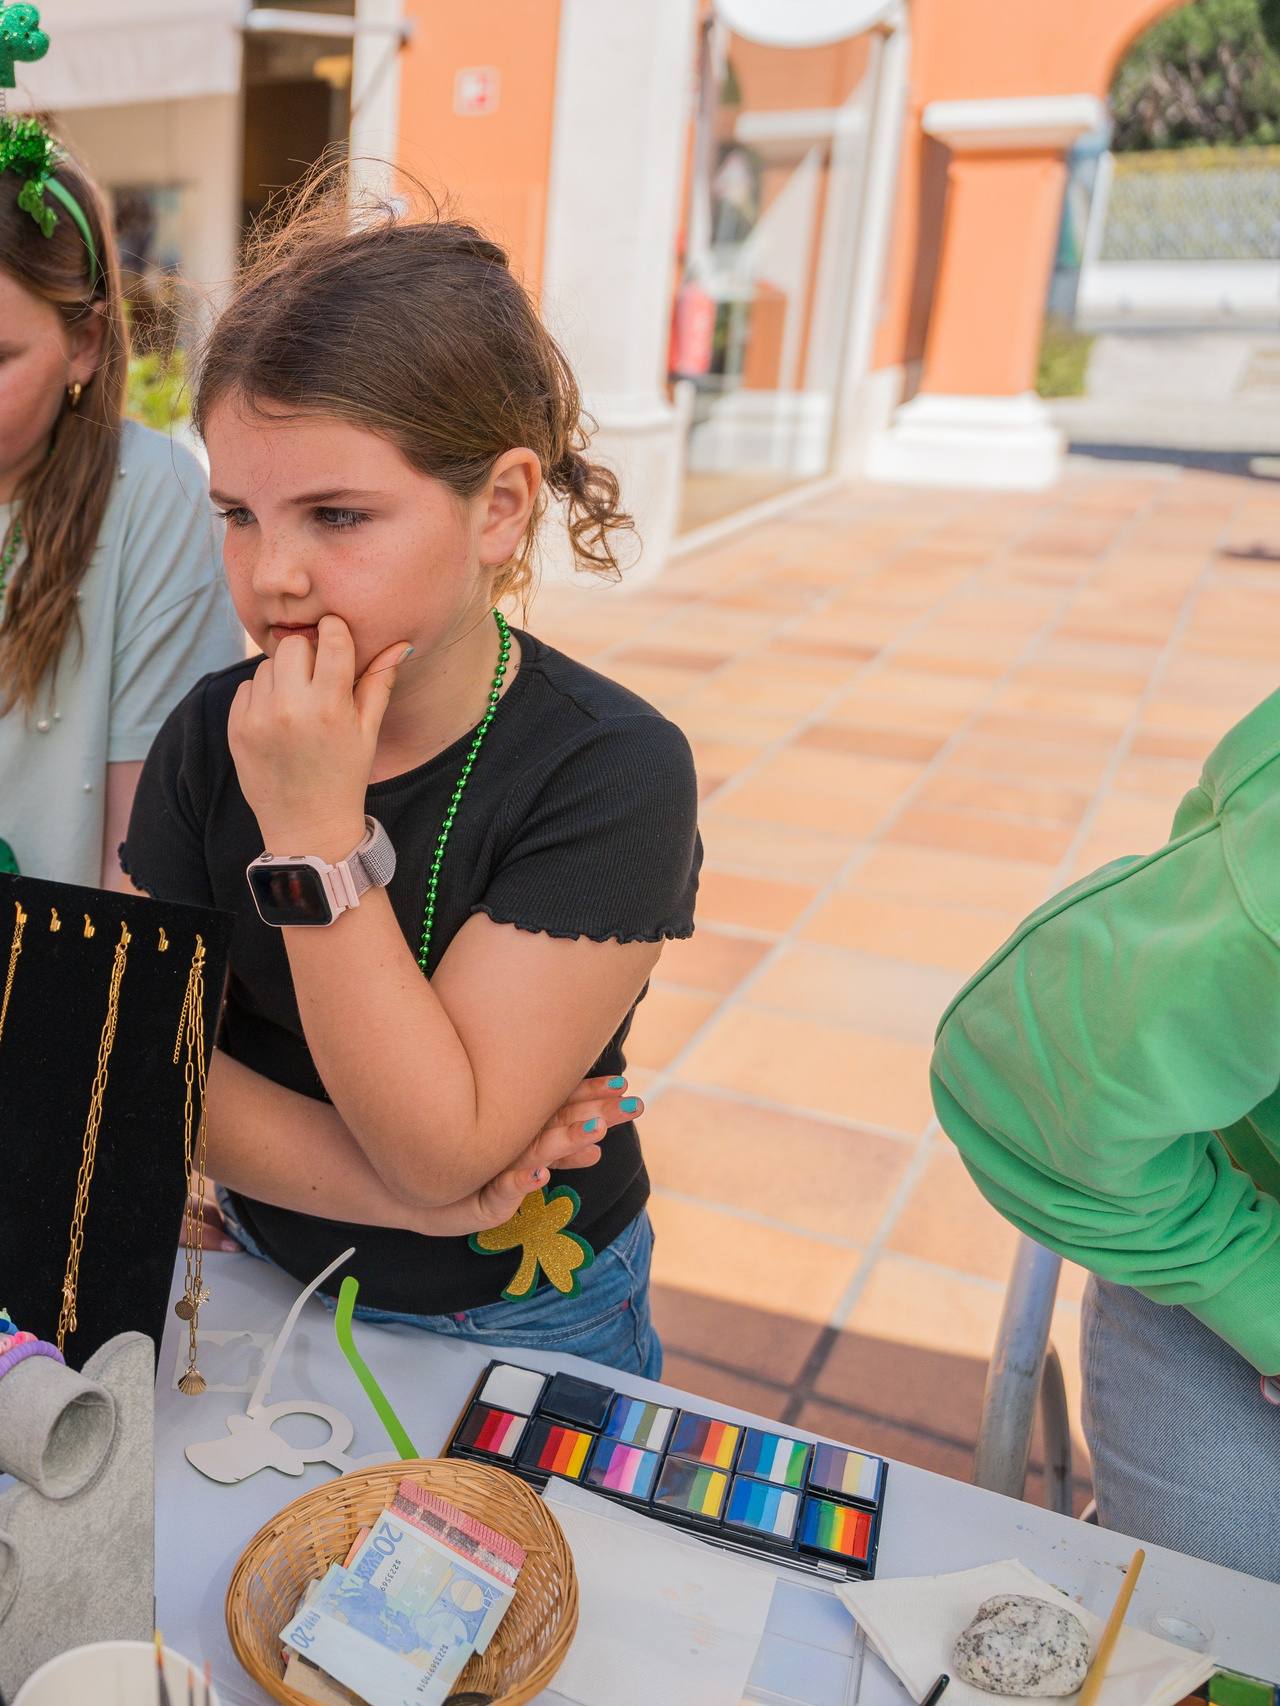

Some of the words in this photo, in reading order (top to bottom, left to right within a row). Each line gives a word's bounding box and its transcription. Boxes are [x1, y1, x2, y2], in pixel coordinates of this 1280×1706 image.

[372, 1522, 404, 1556] 20
[480, 1586, 502, 1610] 20
[290, 1625, 316, 1648] 20
